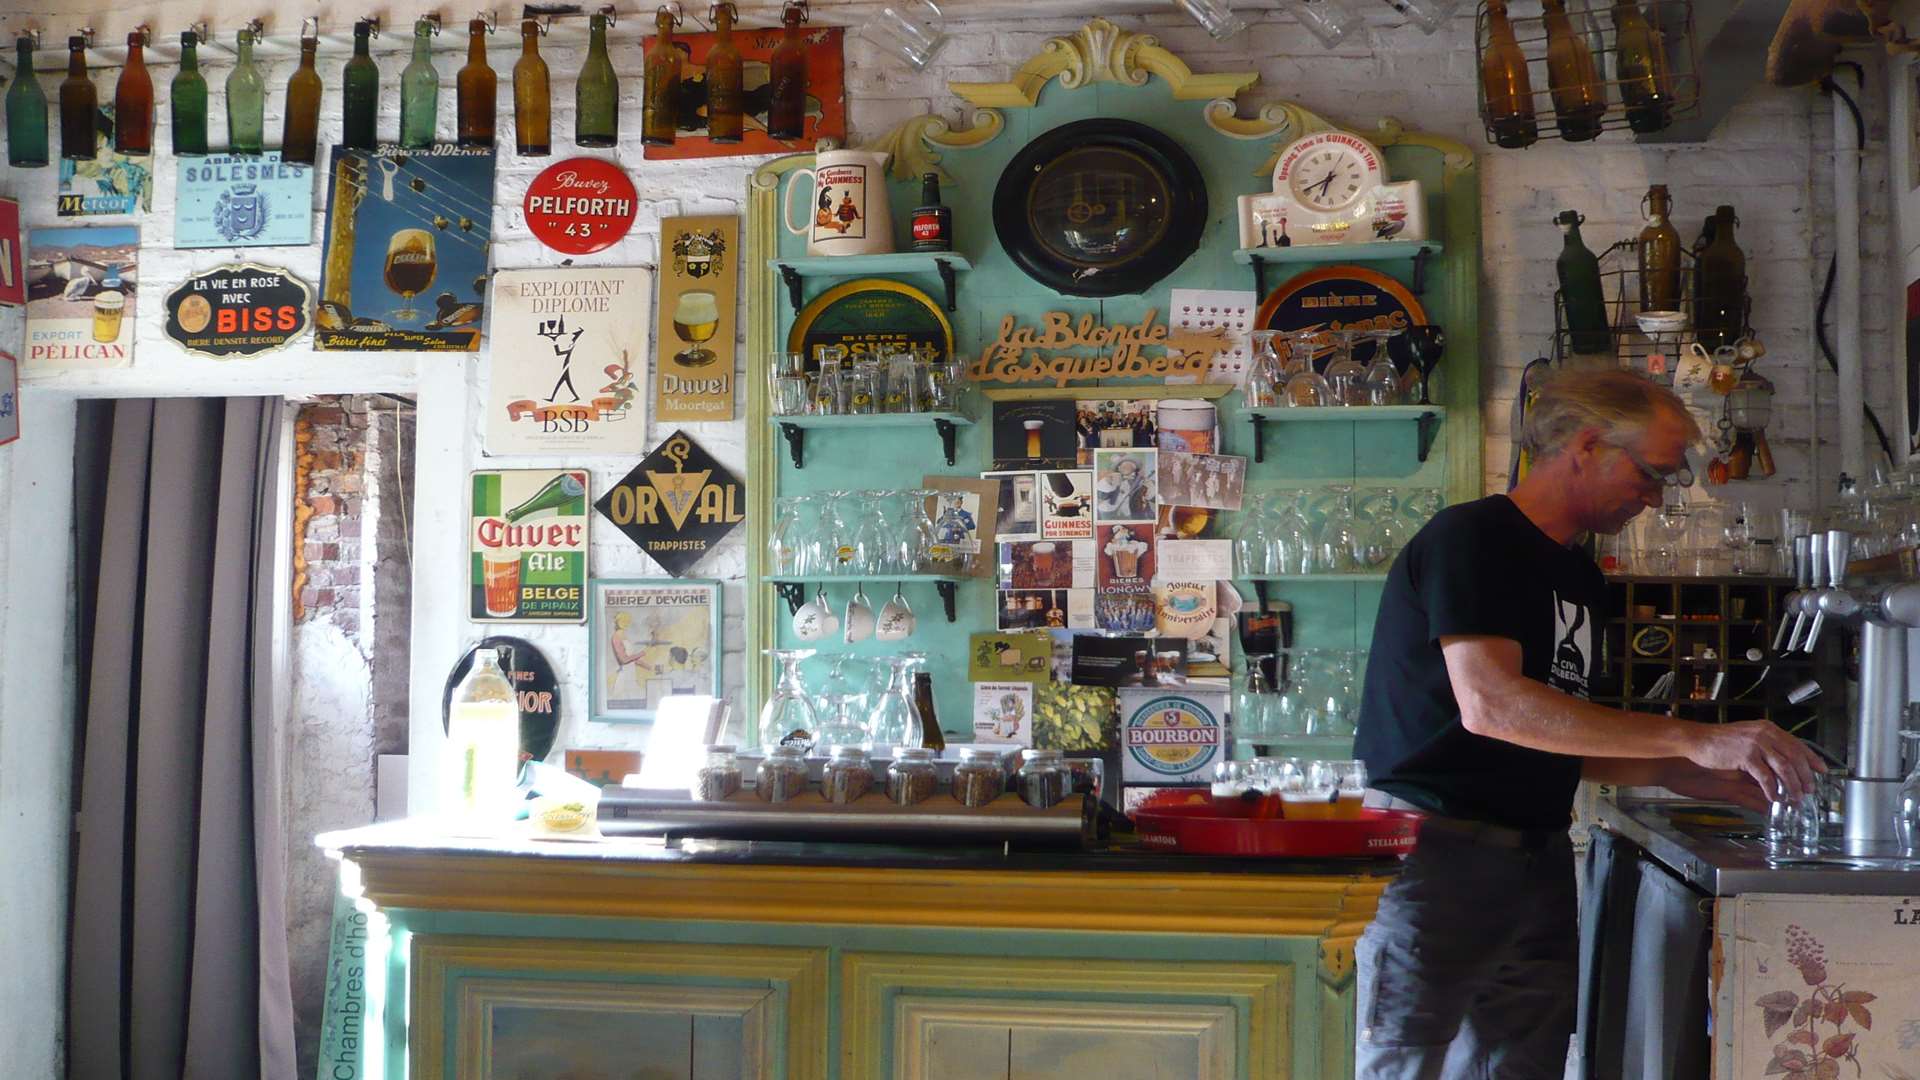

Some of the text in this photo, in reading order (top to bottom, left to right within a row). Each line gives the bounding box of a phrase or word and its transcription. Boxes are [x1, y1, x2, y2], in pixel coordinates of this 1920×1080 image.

[1295, 140, 1314, 152] Time
[1326, 135, 1366, 154] GUINNESS
[1364, 152, 1377, 171] TIME
[186, 164, 303, 182] SOLESMES
[825, 176, 863, 185] GUINNESS
[553, 171, 612, 195] Buvez
[59, 196, 129, 213] Meteor
[529, 196, 631, 217] PELFORTH
[194, 277, 281, 290] LA VIE EN ROSE
[520, 280, 625, 298] EXPLOITANT
[222, 293, 251, 304] AVEC
[217, 305, 297, 333] BISS
[1038, 307, 1168, 348] Blonde
[32, 330, 83, 341] EXPORT
[250, 336, 285, 345] RECORD
[31, 343, 125, 360] PÉLICAN
[662, 373, 729, 394] Duvel
[664, 399, 726, 412] Moortgat
[543, 410, 590, 433] BSB
[611, 470, 745, 532] ORVAL
[1045, 520, 1092, 529] GUINNESS
[1059, 529, 1091, 537] STRENGTH
[478, 519, 582, 548] Cuver
[648, 540, 706, 551] TRAPPISTES
[528, 552, 566, 571] Ale
[522, 587, 580, 600] BELGE
[607, 595, 708, 606] BIERES DEVIGNE
[522, 601, 579, 610] DE PIPAIX
[1130, 729, 1216, 743] BOURBON
[1368, 838, 1398, 848] STELLA
[345, 910, 369, 959] d'hô
[333, 966, 364, 1080] Chambres
